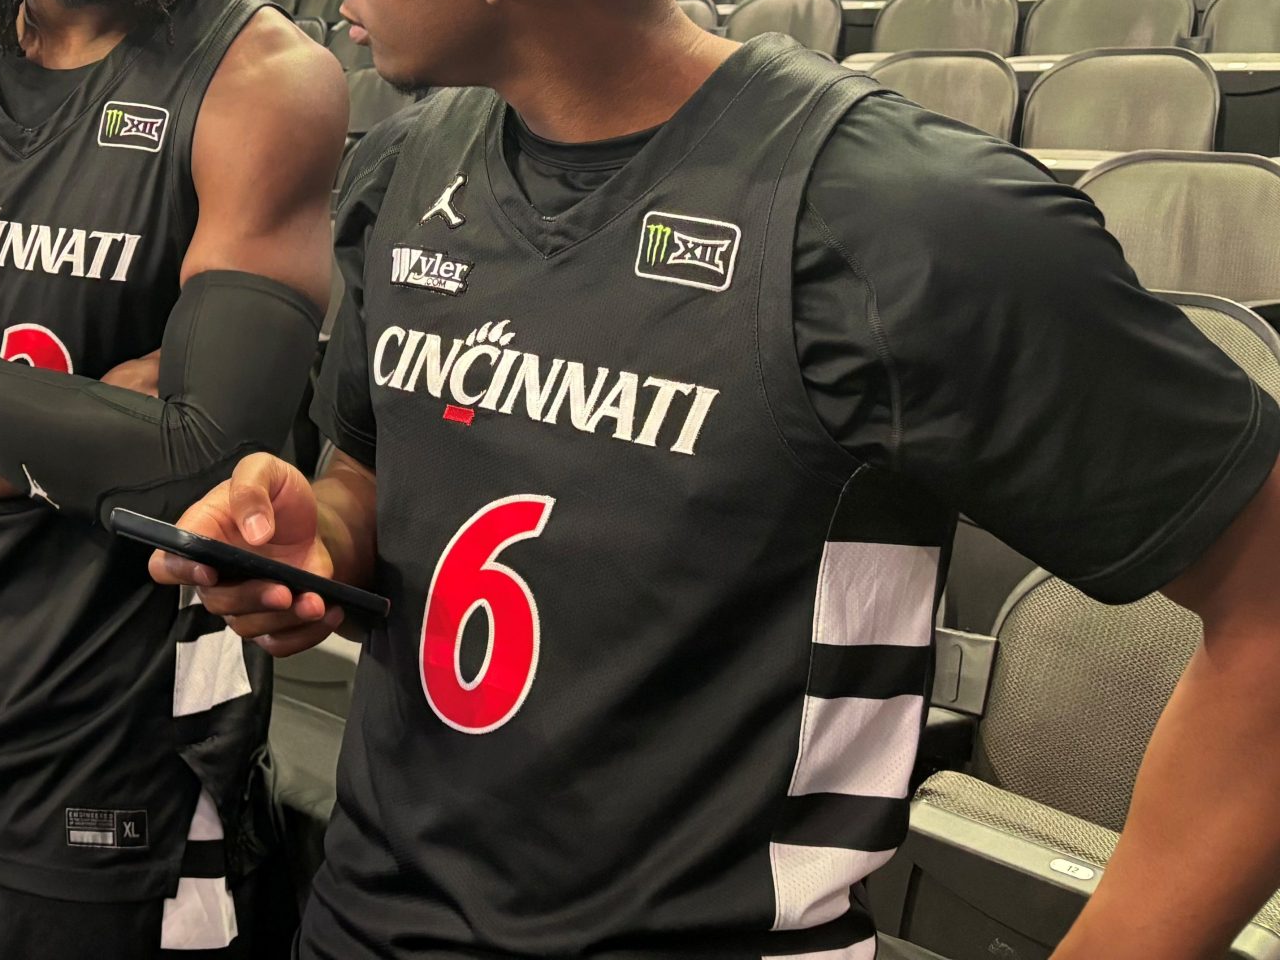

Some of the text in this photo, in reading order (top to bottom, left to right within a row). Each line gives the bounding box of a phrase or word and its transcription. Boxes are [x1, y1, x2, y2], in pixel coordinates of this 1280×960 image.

[391, 247, 469, 283] Wyler
[373, 320, 721, 456] CINCINNATI
[418, 493, 557, 735] 6
[122, 821, 140, 838] XL
